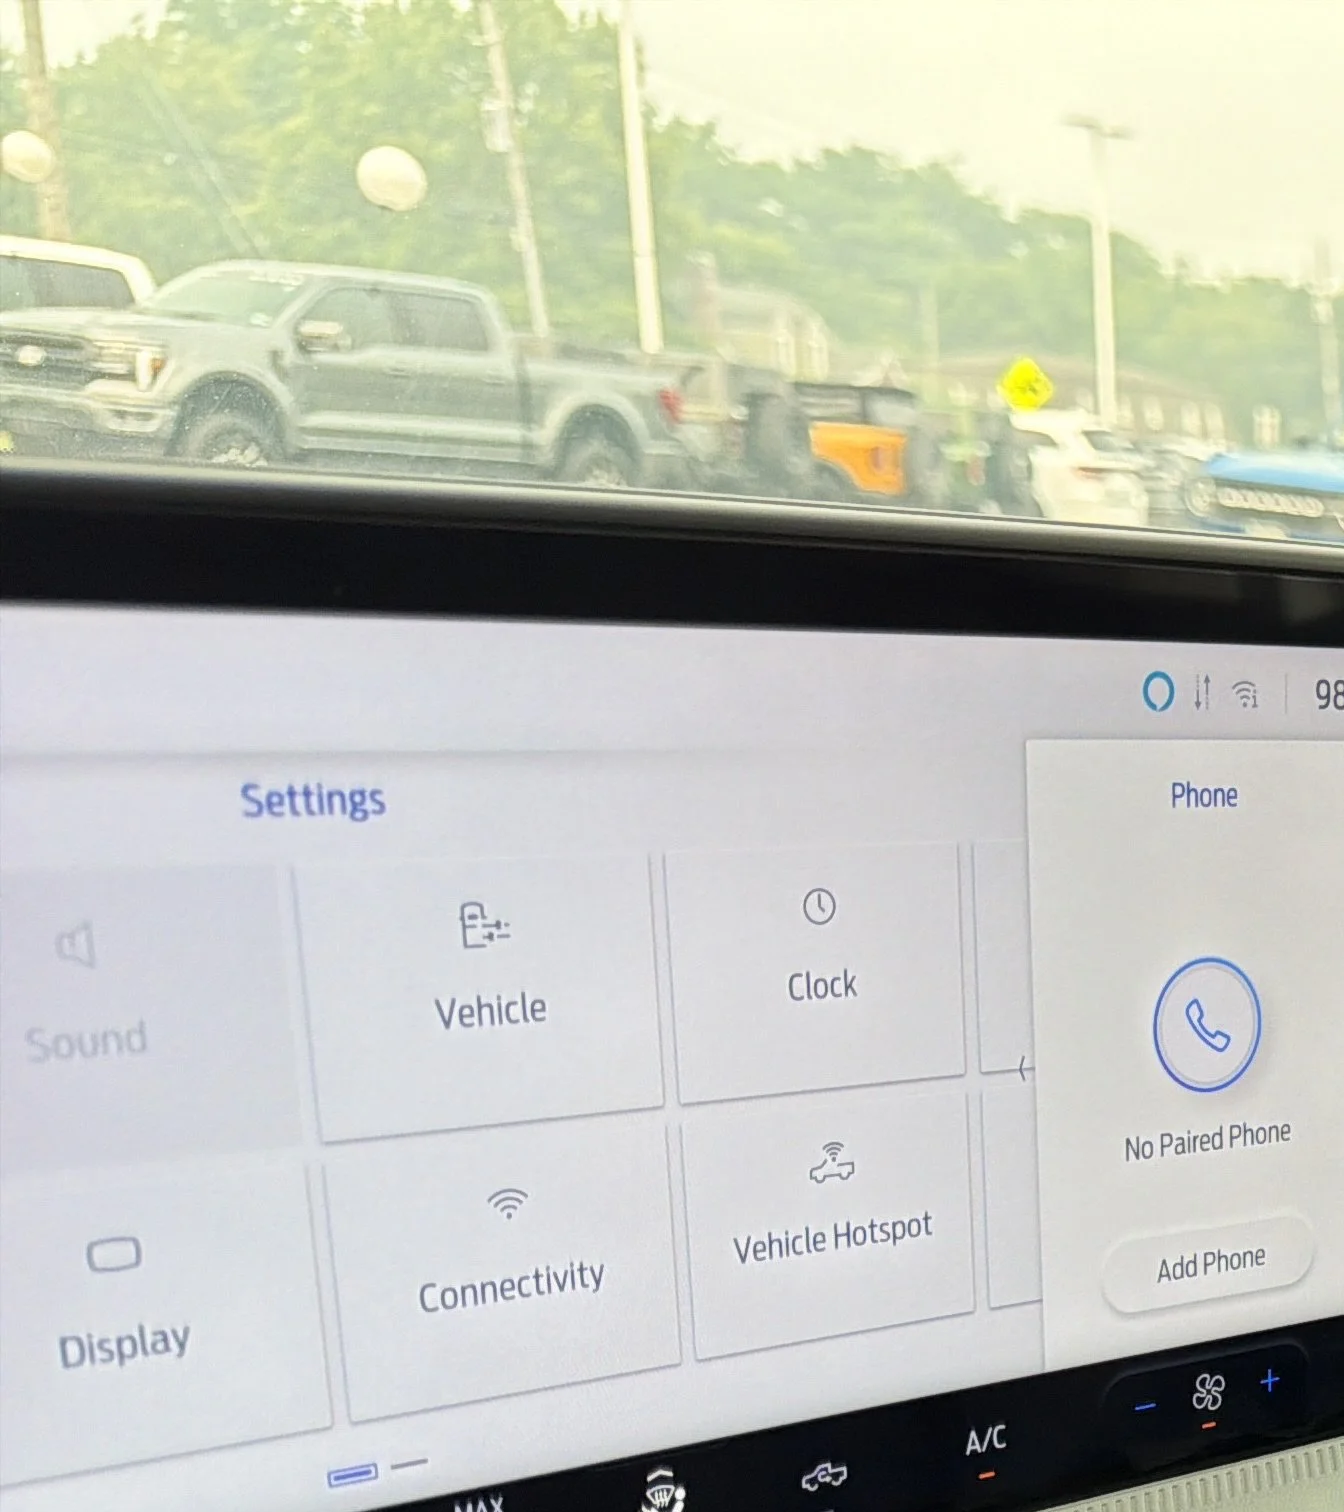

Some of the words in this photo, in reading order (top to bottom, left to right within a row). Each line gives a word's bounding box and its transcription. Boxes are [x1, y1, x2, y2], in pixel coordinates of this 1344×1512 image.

[241, 783, 385, 822] Settings
[1172, 781, 1237, 807] Phone
[789, 969, 857, 1001] Clock
[435, 992, 546, 1029] Vehicle
[25, 1019, 147, 1063] Sound
[1126, 1137, 1153, 1161] No
[1161, 1126, 1223, 1157] Paired
[1230, 1123, 1290, 1148] Phone
[734, 1227, 826, 1263] Vehicle
[834, 1212, 932, 1249] Hotspot
[1158, 1254, 1197, 1283] Add
[1204, 1249, 1265, 1275] Phone
[420, 1262, 604, 1312] Connectivity
[59, 1324, 189, 1369] Display
[966, 1425, 1006, 1455] A/C
